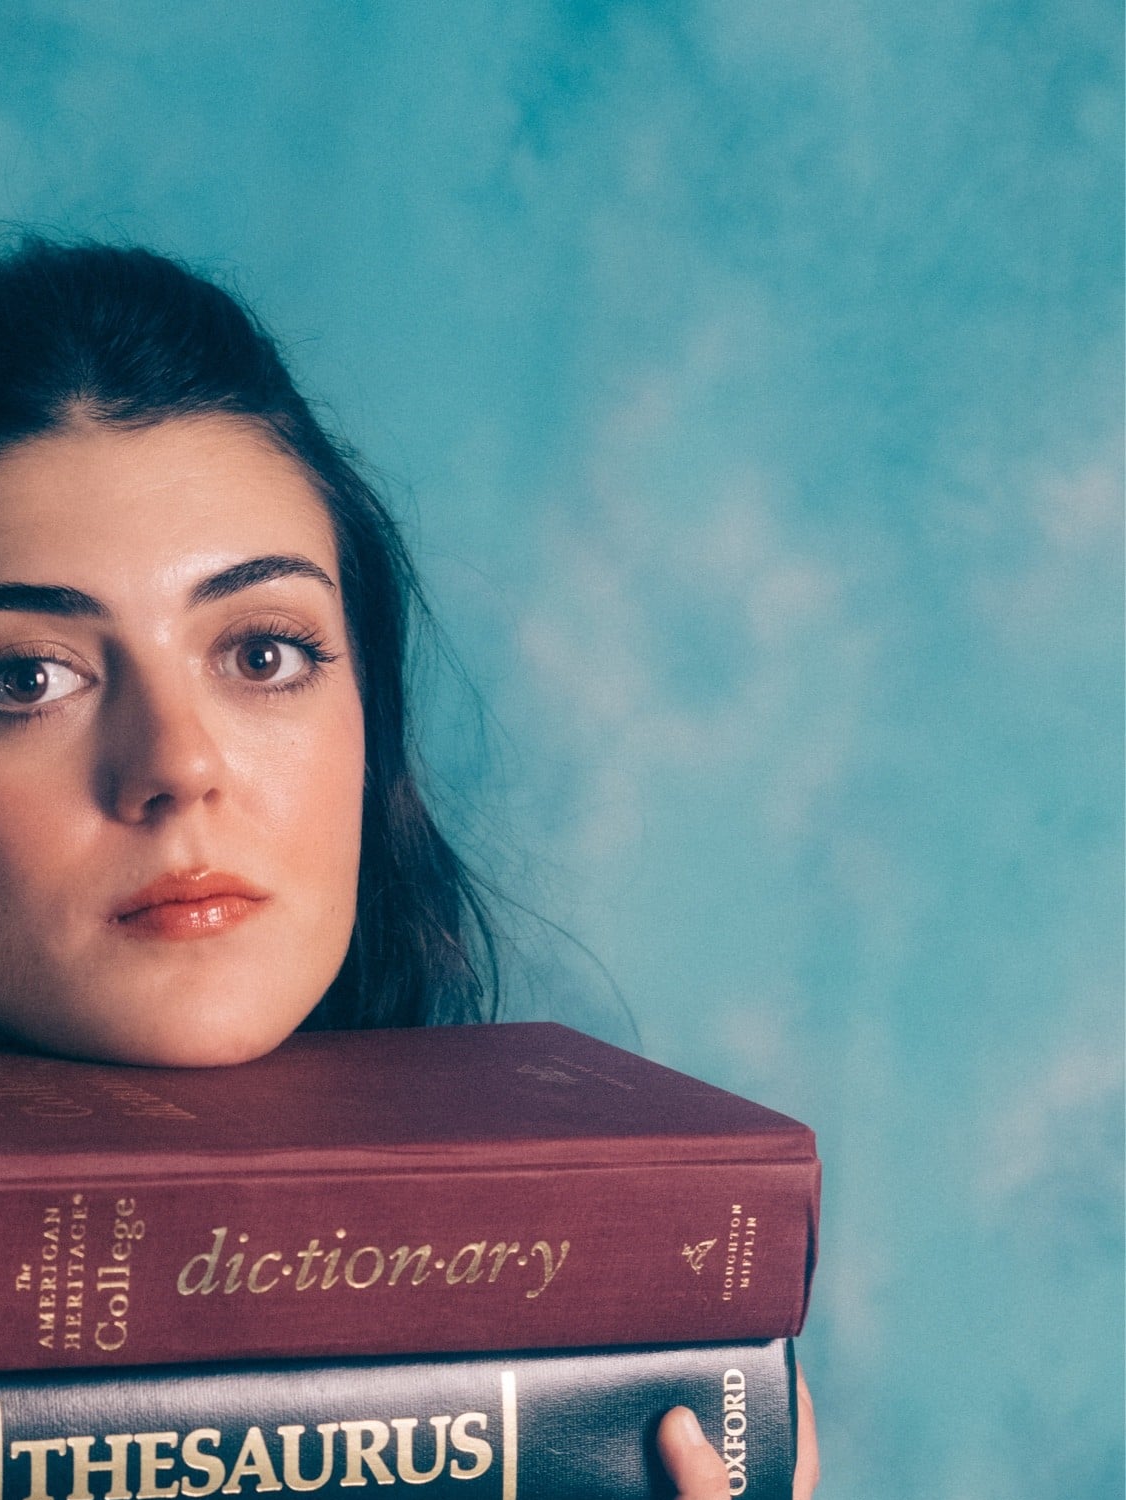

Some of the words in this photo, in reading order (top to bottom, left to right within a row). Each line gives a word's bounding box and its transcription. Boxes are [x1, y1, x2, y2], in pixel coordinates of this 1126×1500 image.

[15, 1262, 33, 1292] The
[38, 1207, 61, 1350] AMERICAN
[94, 1197, 146, 1351] College
[722, 1203, 742, 1301] HOUGHTON
[739, 1216, 758, 1288] MIFFLIN
[722, 1367, 747, 1497] OXFORD
